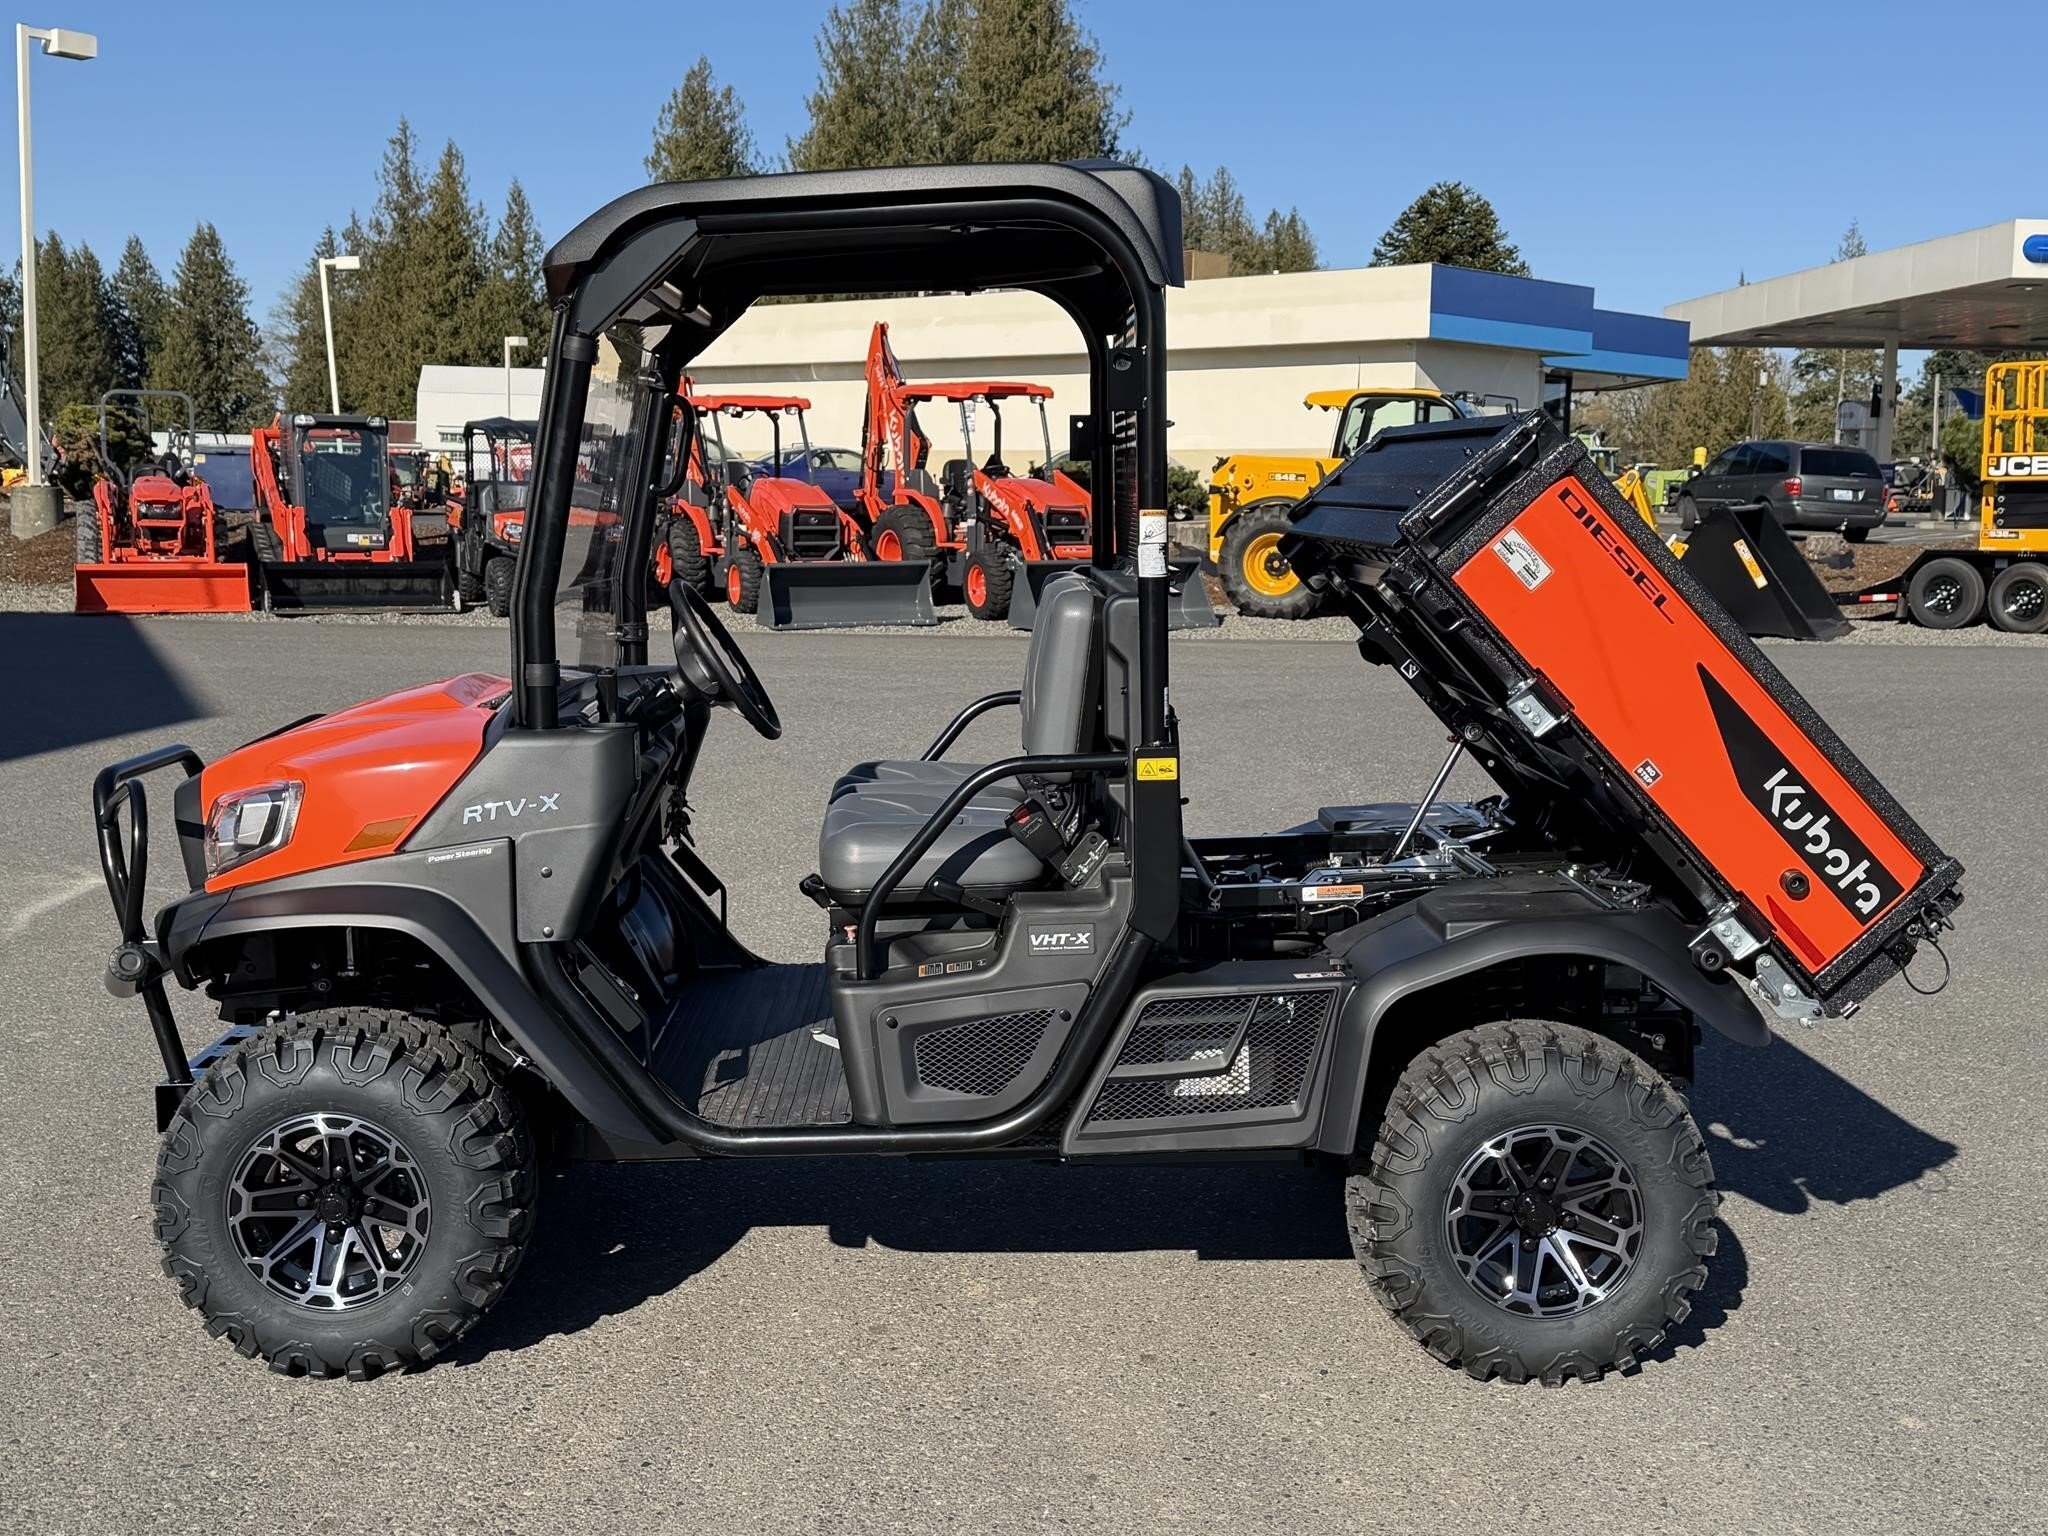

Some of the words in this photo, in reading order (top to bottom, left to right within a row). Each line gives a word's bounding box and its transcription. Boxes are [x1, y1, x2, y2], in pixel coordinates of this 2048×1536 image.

[1558, 487, 1675, 624] DIESEL
[1637, 767, 1653, 783] STEP
[1645, 765, 1656, 777] NO
[462, 793, 561, 825] RTV-X
[1763, 767, 1881, 915] Kubota
[427, 853, 455, 863] Power
[455, 848, 492, 859] Steering
[1030, 932, 1091, 946] VHT-X
